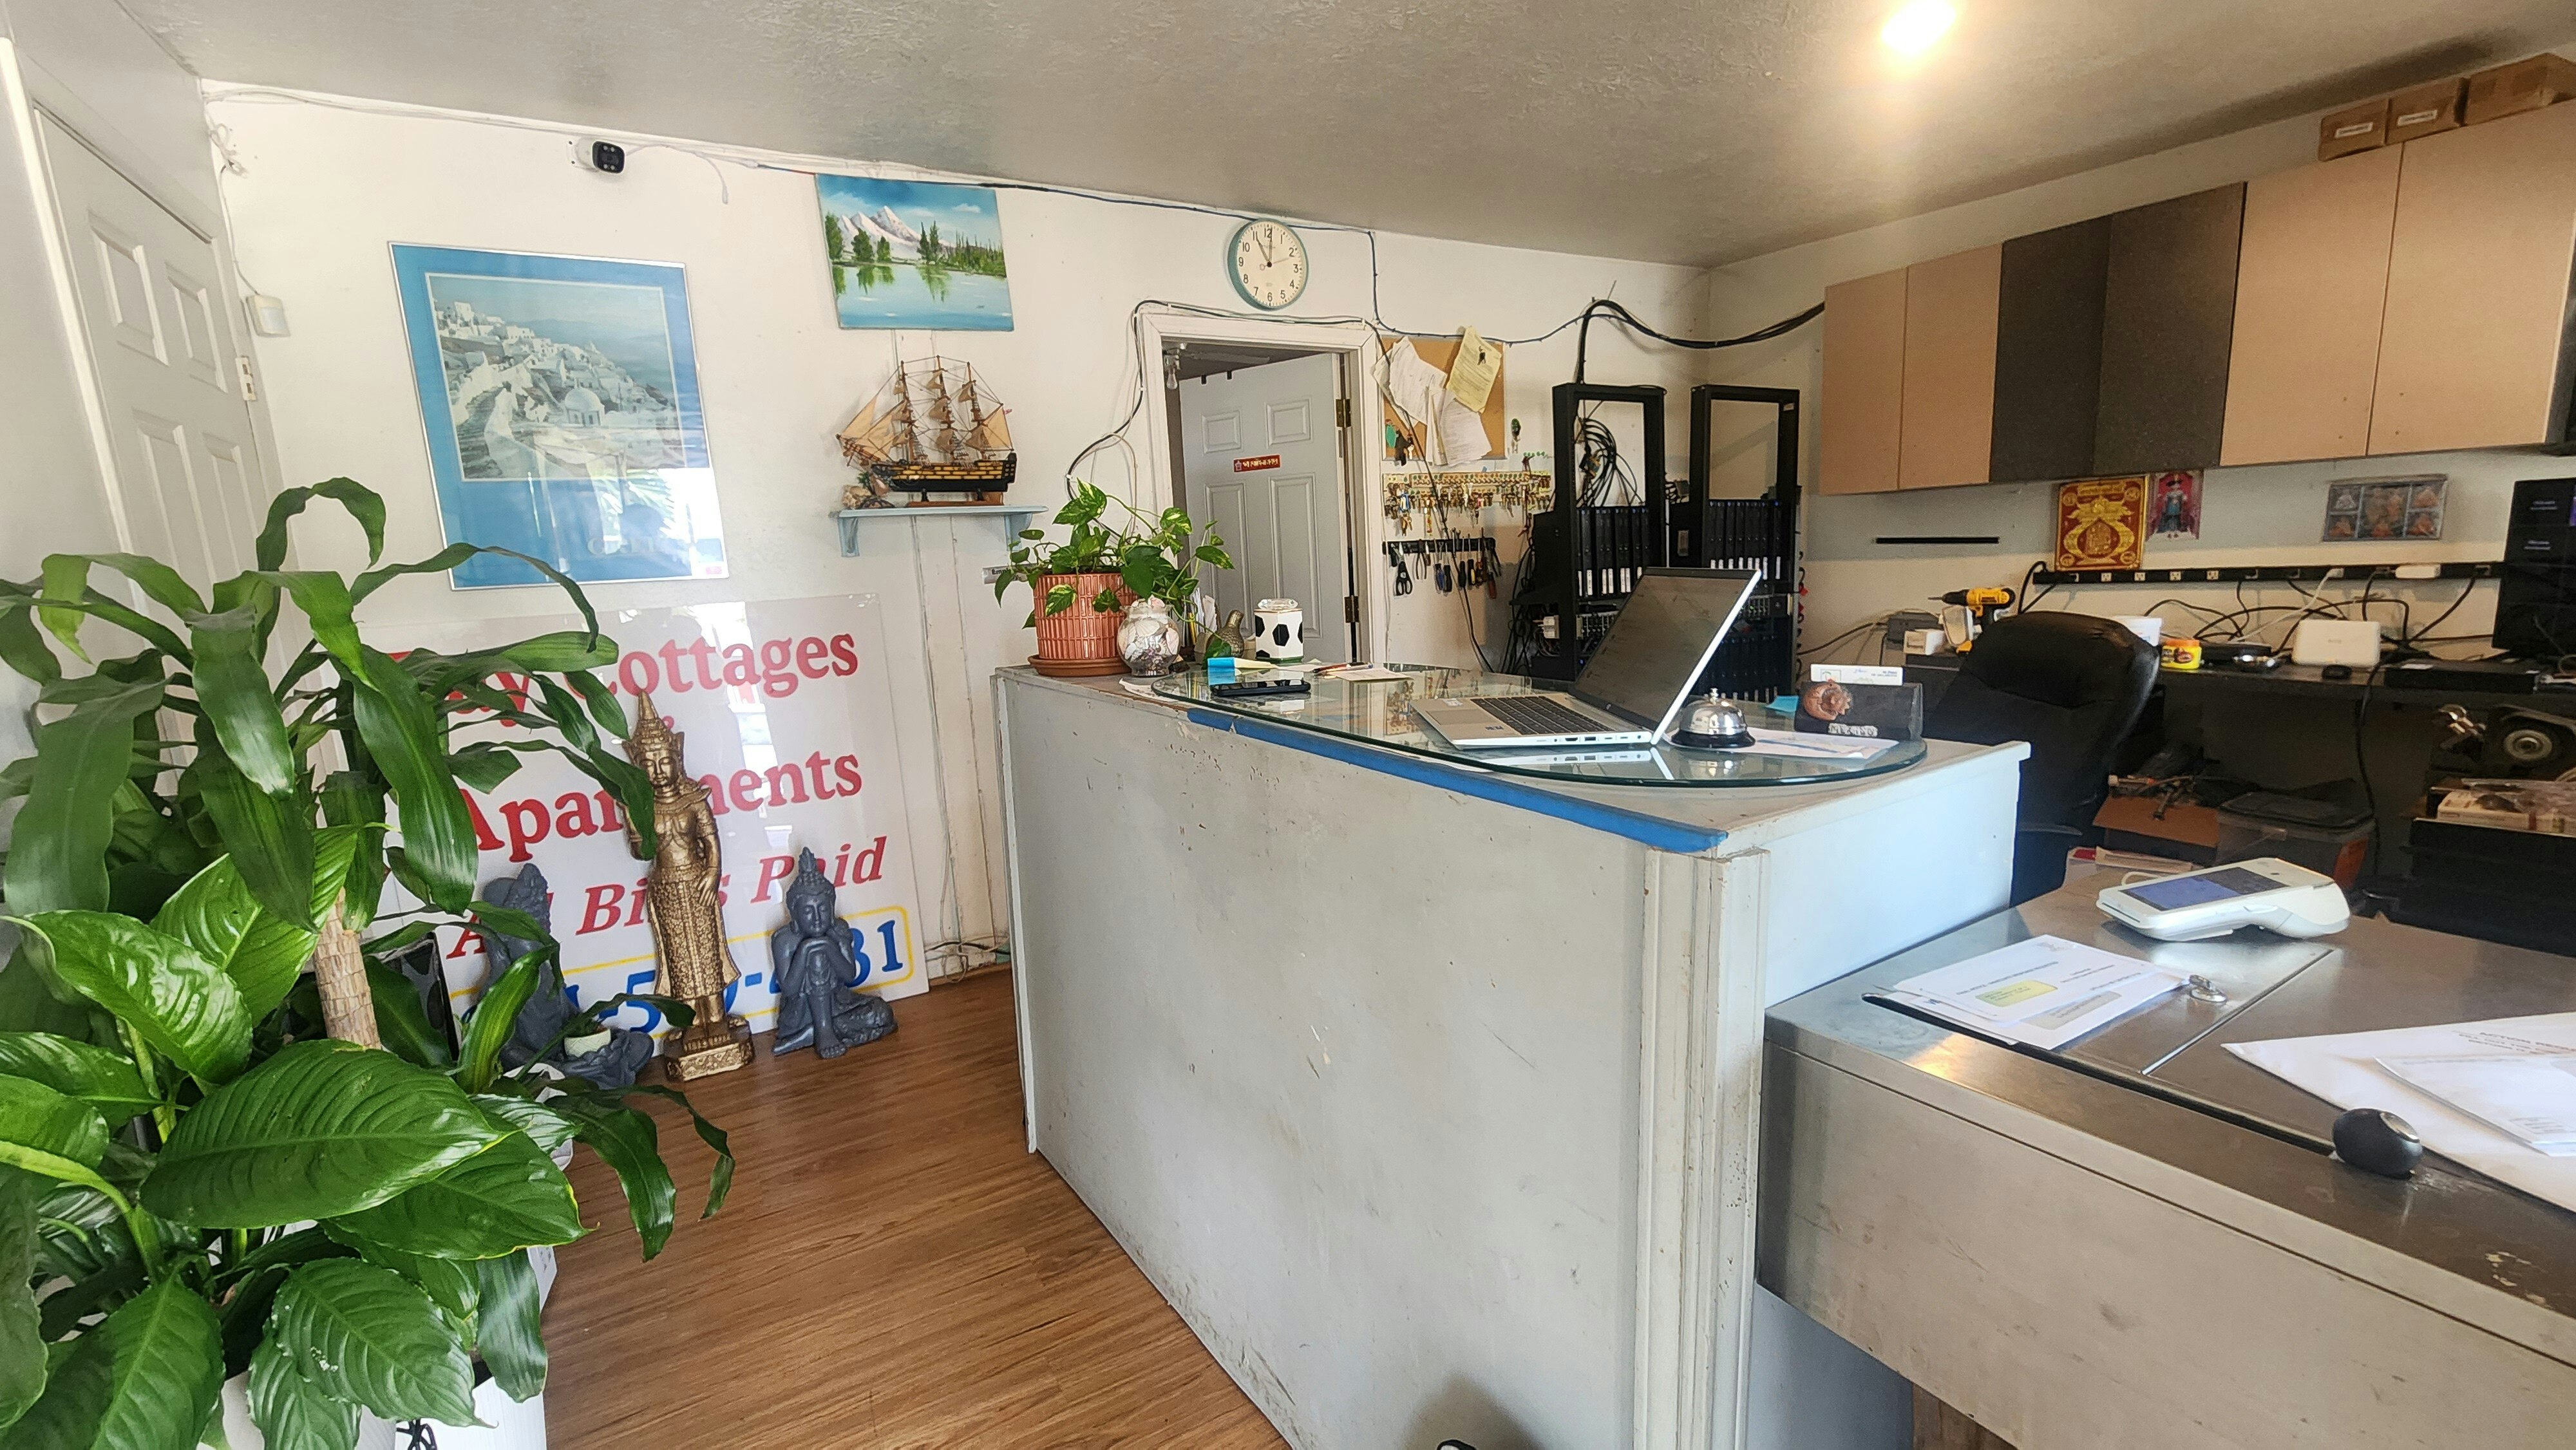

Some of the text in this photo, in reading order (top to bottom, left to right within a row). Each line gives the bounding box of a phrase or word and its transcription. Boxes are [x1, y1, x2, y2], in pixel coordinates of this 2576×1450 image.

[1242, 242, 1251, 252] 10
[1289, 247, 1294, 258] 2
[1238, 257, 1244, 267] 9
[1293, 263, 1299, 274] 3
[1243, 274, 1249, 284] 8
[1289, 279, 1295, 288] 4
[1253, 287, 1259, 296] 7
[1280, 290, 1286, 299] 5
[1267, 292, 1273, 302] 6
[563, 633, 858, 698] ottages
[460, 751, 863, 862] Aparents
[575, 874, 731, 935] Bis
[750, 836, 887, 904] Pid
